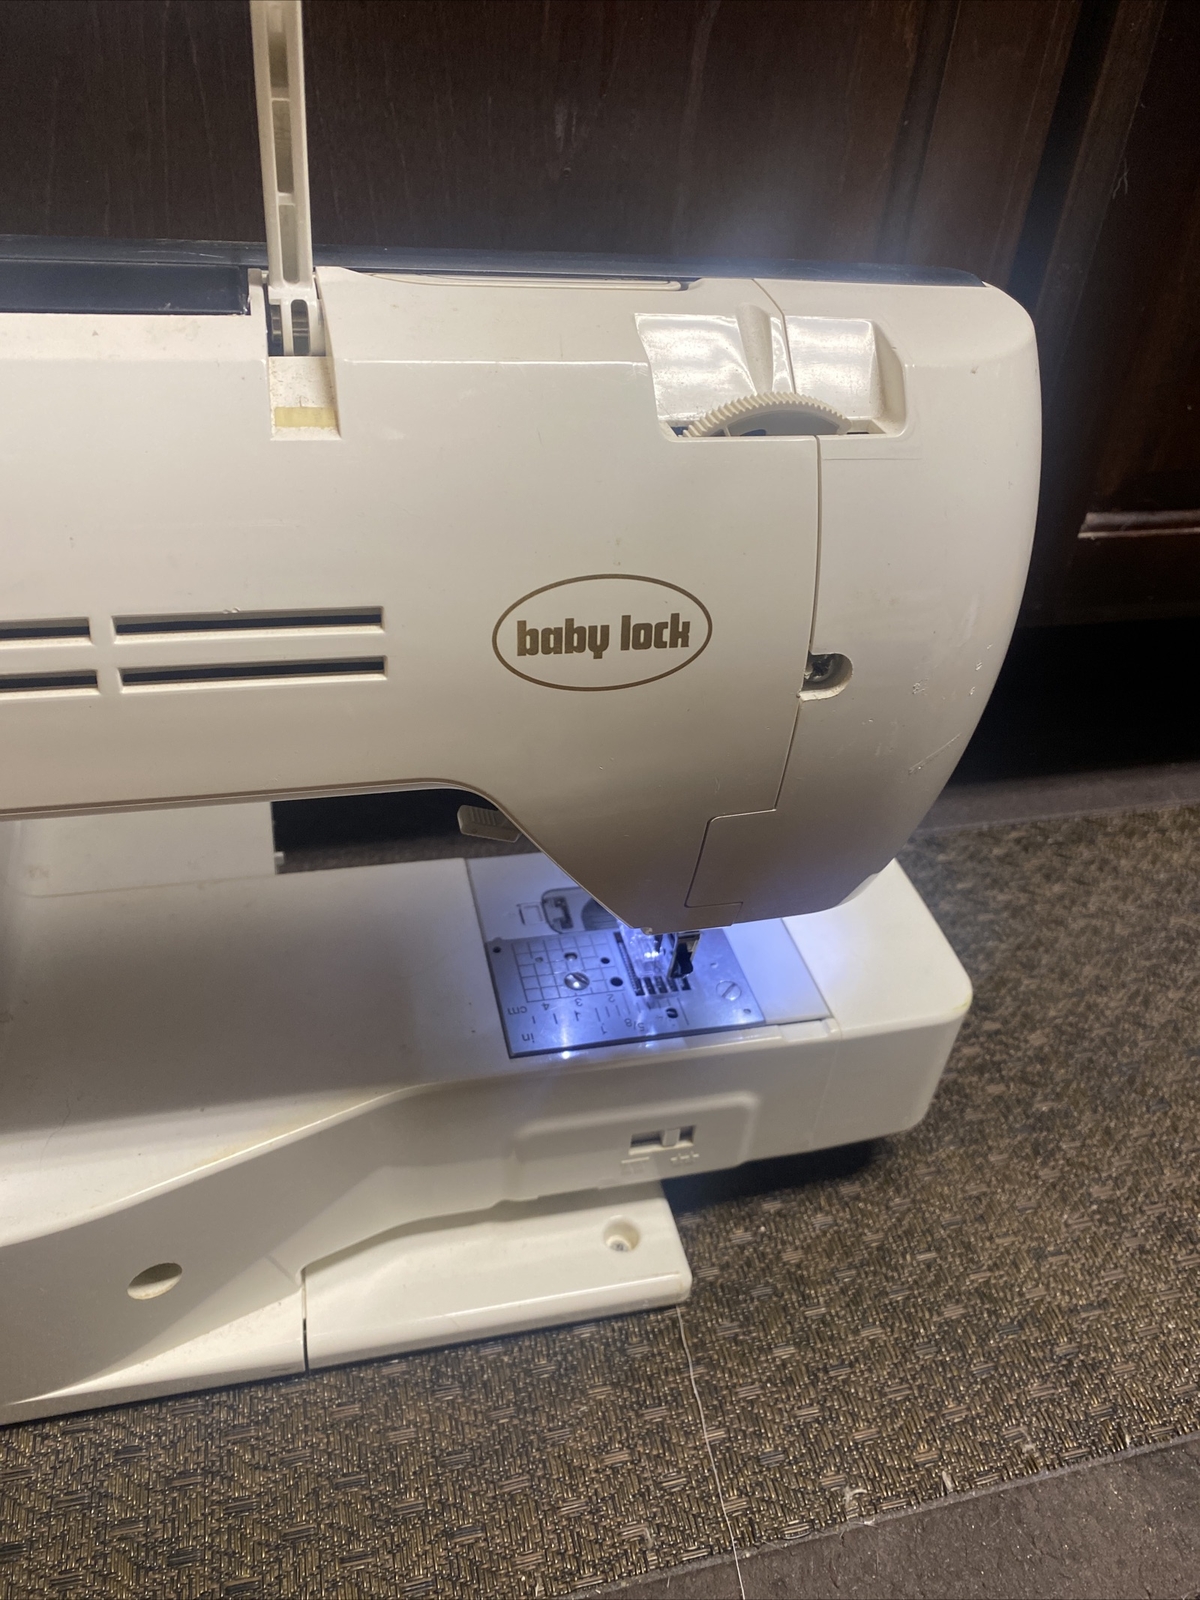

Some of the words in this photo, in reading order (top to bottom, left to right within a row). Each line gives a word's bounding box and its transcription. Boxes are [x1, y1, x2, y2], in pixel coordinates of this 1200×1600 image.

[516, 618, 610, 660] baby
[620, 612, 691, 651] lock
[574, 997, 583, 1007] 3
[606, 993, 616, 1003] 2
[507, 1005, 528, 1016] cm
[541, 1002, 550, 1011] 4
[624, 1018, 645, 1032] 5/8
[521, 1032, 535, 1043] in
